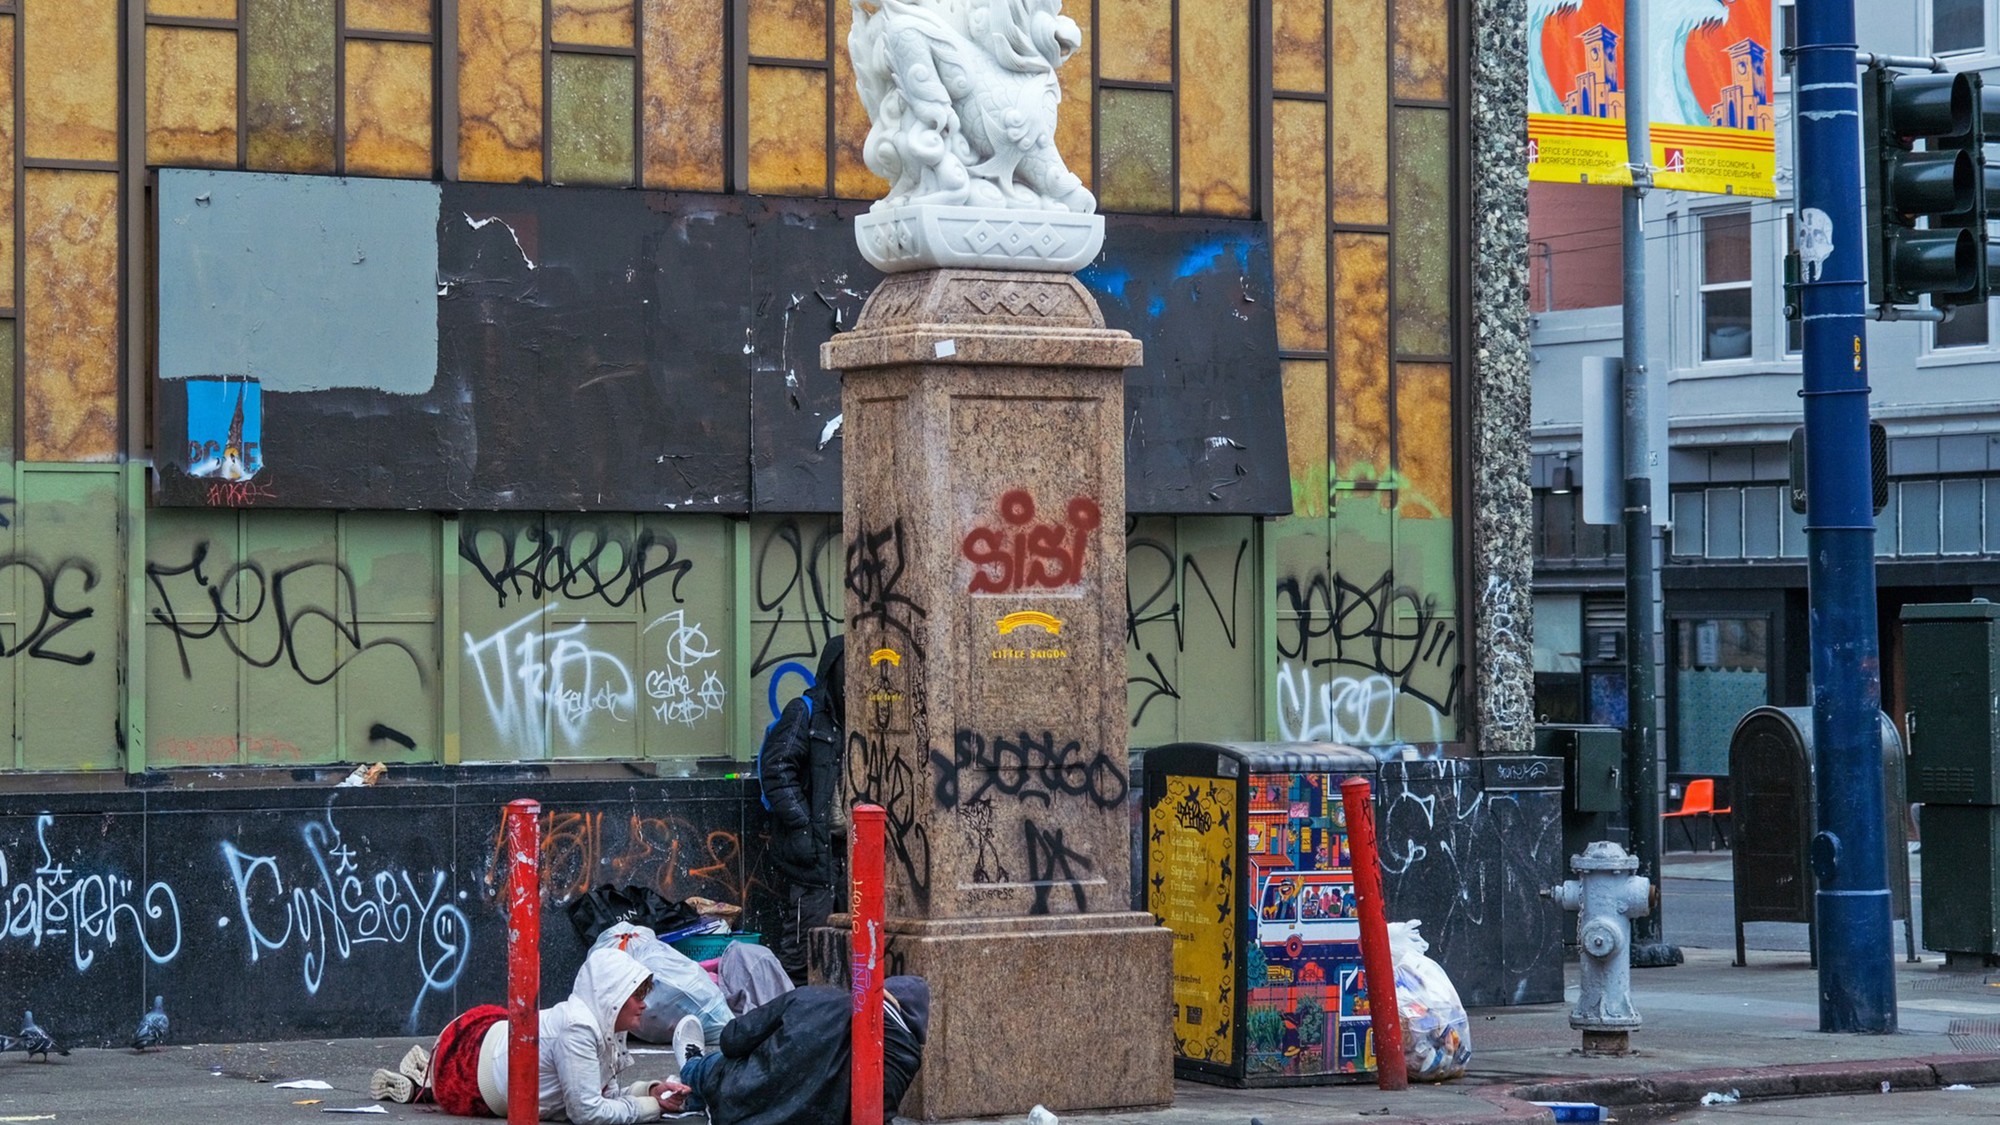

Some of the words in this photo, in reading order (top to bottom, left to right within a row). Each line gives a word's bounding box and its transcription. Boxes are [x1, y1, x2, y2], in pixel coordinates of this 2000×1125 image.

[1540, 146, 1561, 156] OFFICE
[1562, 147, 1571, 156] OF
[1572, 148, 1604, 158] ECONOMIC
[1540, 156, 1577, 166] WORKFORCE
[1577, 158, 1617, 168] DEVELOPMENT
[1685, 156, 1707, 166] OFFICE
[1708, 158, 1716, 166] OF
[1717, 159, 1750, 170] ECONOMIC
[1685, 166, 1722, 177] WORKFORCE
[1723, 169, 1762, 179] DEVELOPMENT
[992, 649, 1025, 659] LITTLE
[1030, 649, 1067, 659] SAIGON
[1171, 865, 1183, 879] Sky
[1170, 909, 1183, 921] And
